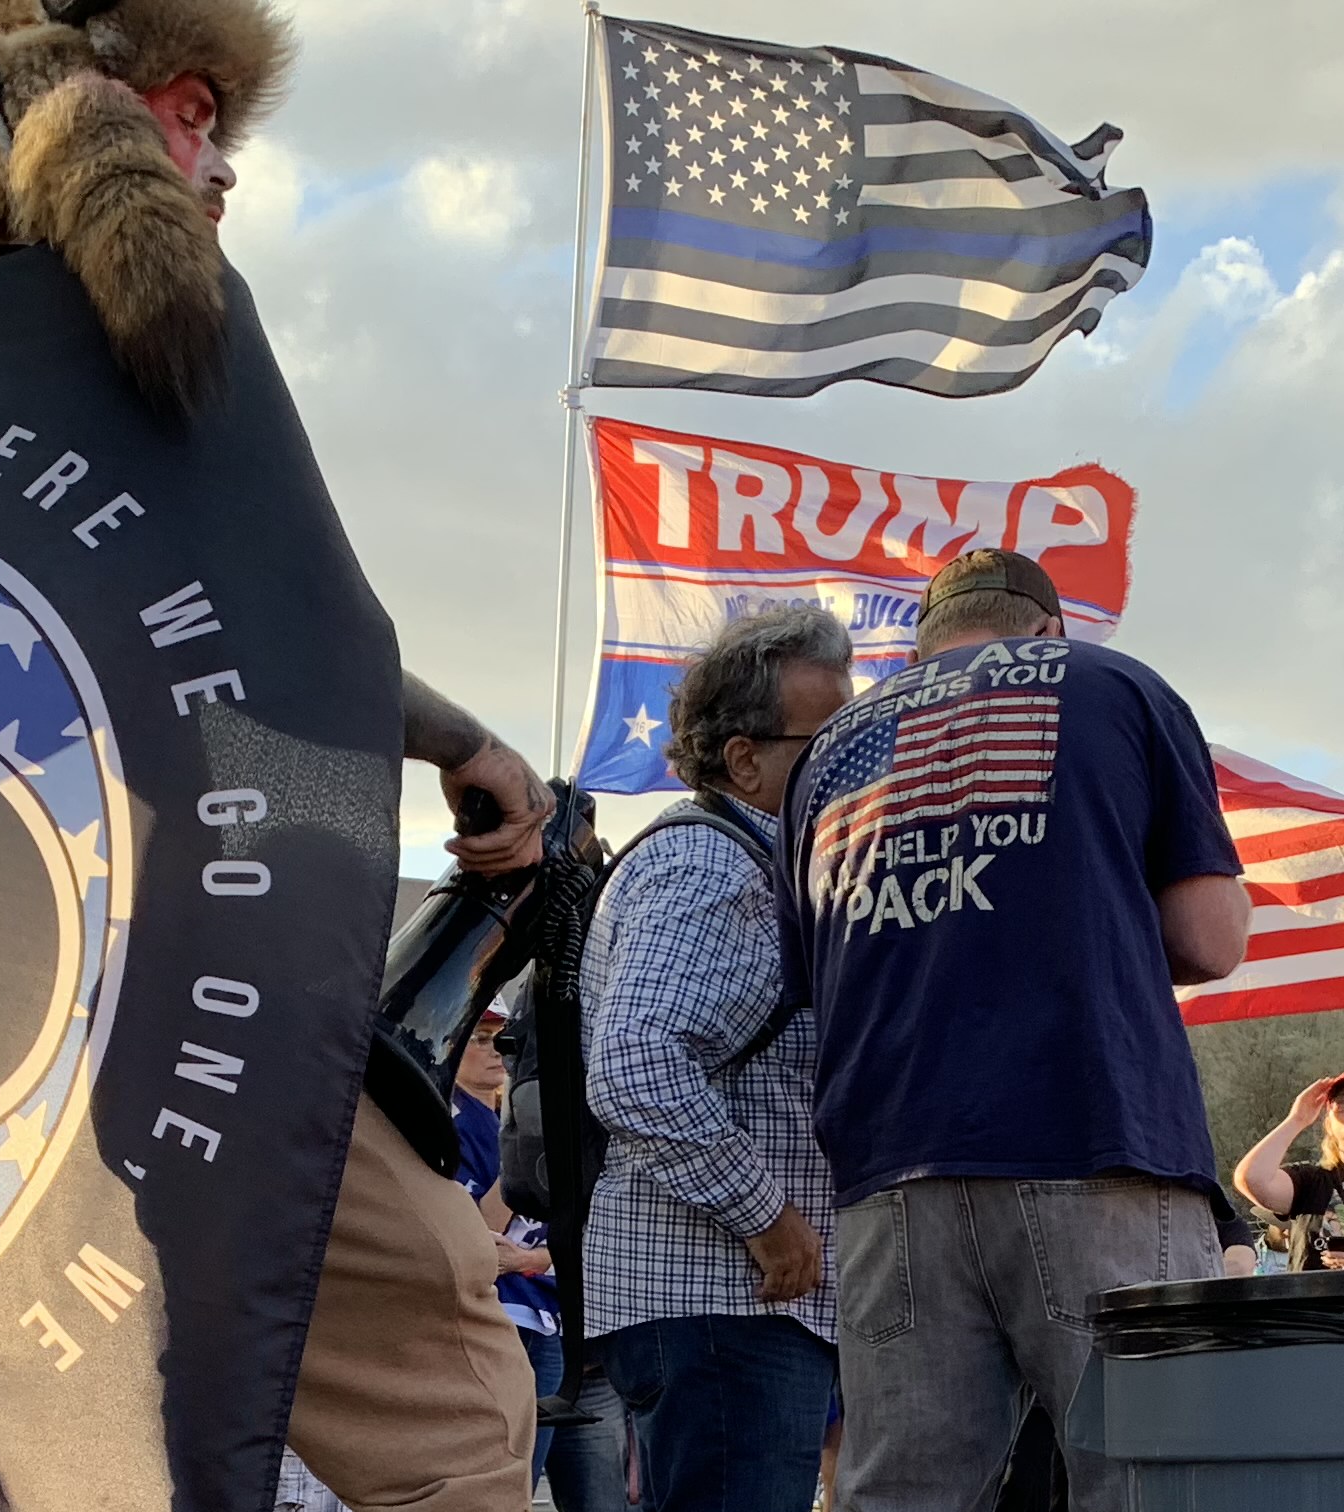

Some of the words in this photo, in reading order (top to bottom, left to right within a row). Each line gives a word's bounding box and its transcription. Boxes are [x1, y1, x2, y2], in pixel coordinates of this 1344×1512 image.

[630, 438, 1110, 562] TRUMP
[139, 580, 248, 718] WE
[847, 592, 922, 632] BULL
[809, 675, 973, 762] OFFENDS
[988, 663, 1067, 687] YOU
[197, 788, 273, 897] GO
[872, 823, 960, 873] HELP
[969, 812, 1048, 848] YOU
[844, 853, 997, 944] PACK
[122, 975, 260, 1182] ONE,
[18, 1242, 145, 1374] WE
